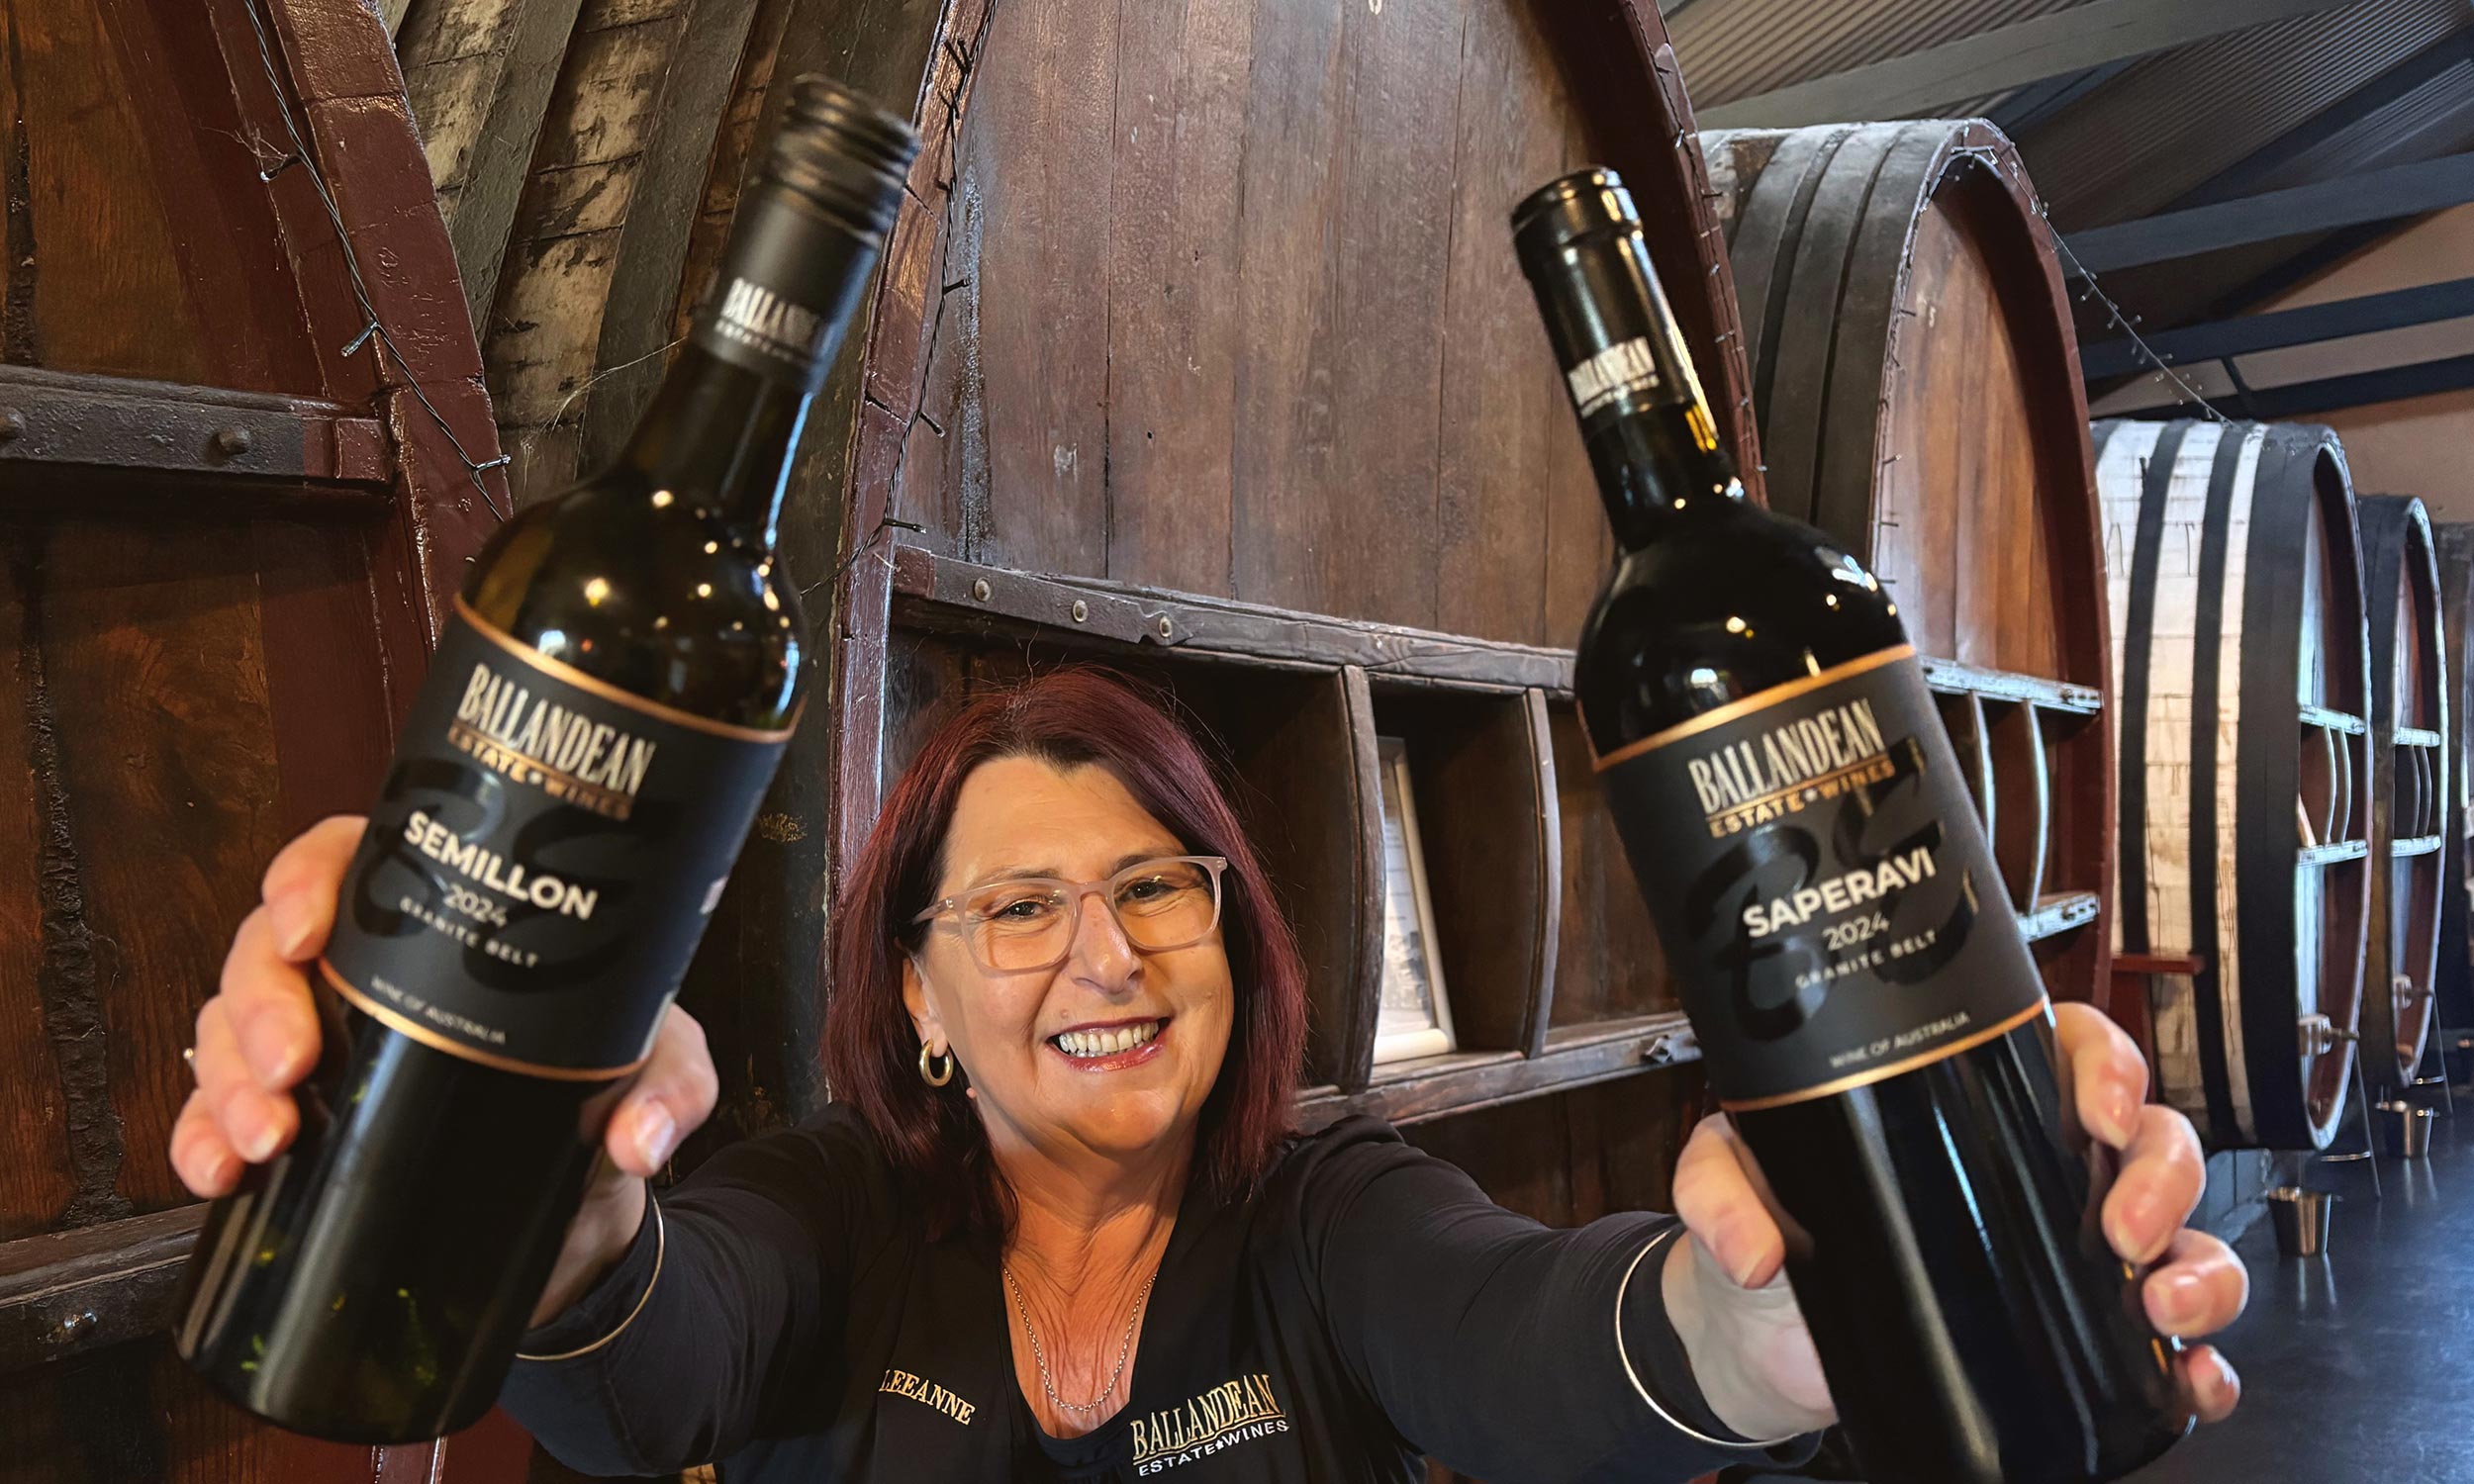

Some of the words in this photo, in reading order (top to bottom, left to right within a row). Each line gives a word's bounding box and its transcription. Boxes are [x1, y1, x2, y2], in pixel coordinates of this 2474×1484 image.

[447, 724, 527, 785] ESTATE
[457, 662, 657, 797] BALLANDEAN
[1688, 697, 1885, 814] BALLANDEAN
[1709, 790, 1806, 839] ESTATE
[1818, 759, 1896, 800] WINES
[404, 811, 598, 921] SEMILLON
[1743, 847, 1937, 938] SAPERAVI
[443, 882, 508, 928] 2024
[1822, 910, 1890, 951] 2024
[485, 939, 538, 969] BELT
[1795, 949, 1884, 989] GRANITE
[1890, 928, 1937, 959] BELT
[1830, 1046, 1868, 1068] WINE
[1869, 1039, 1891, 1056] OF
[1893, 1011, 1971, 1050] AUSTRALIA
[879, 1369, 976, 1426] LEEANNE
[1130, 1373, 1281, 1461] BALLANDEAN
[1138, 1444, 1216, 1477] ESTATE
[1222, 1420, 1289, 1447] WINES
